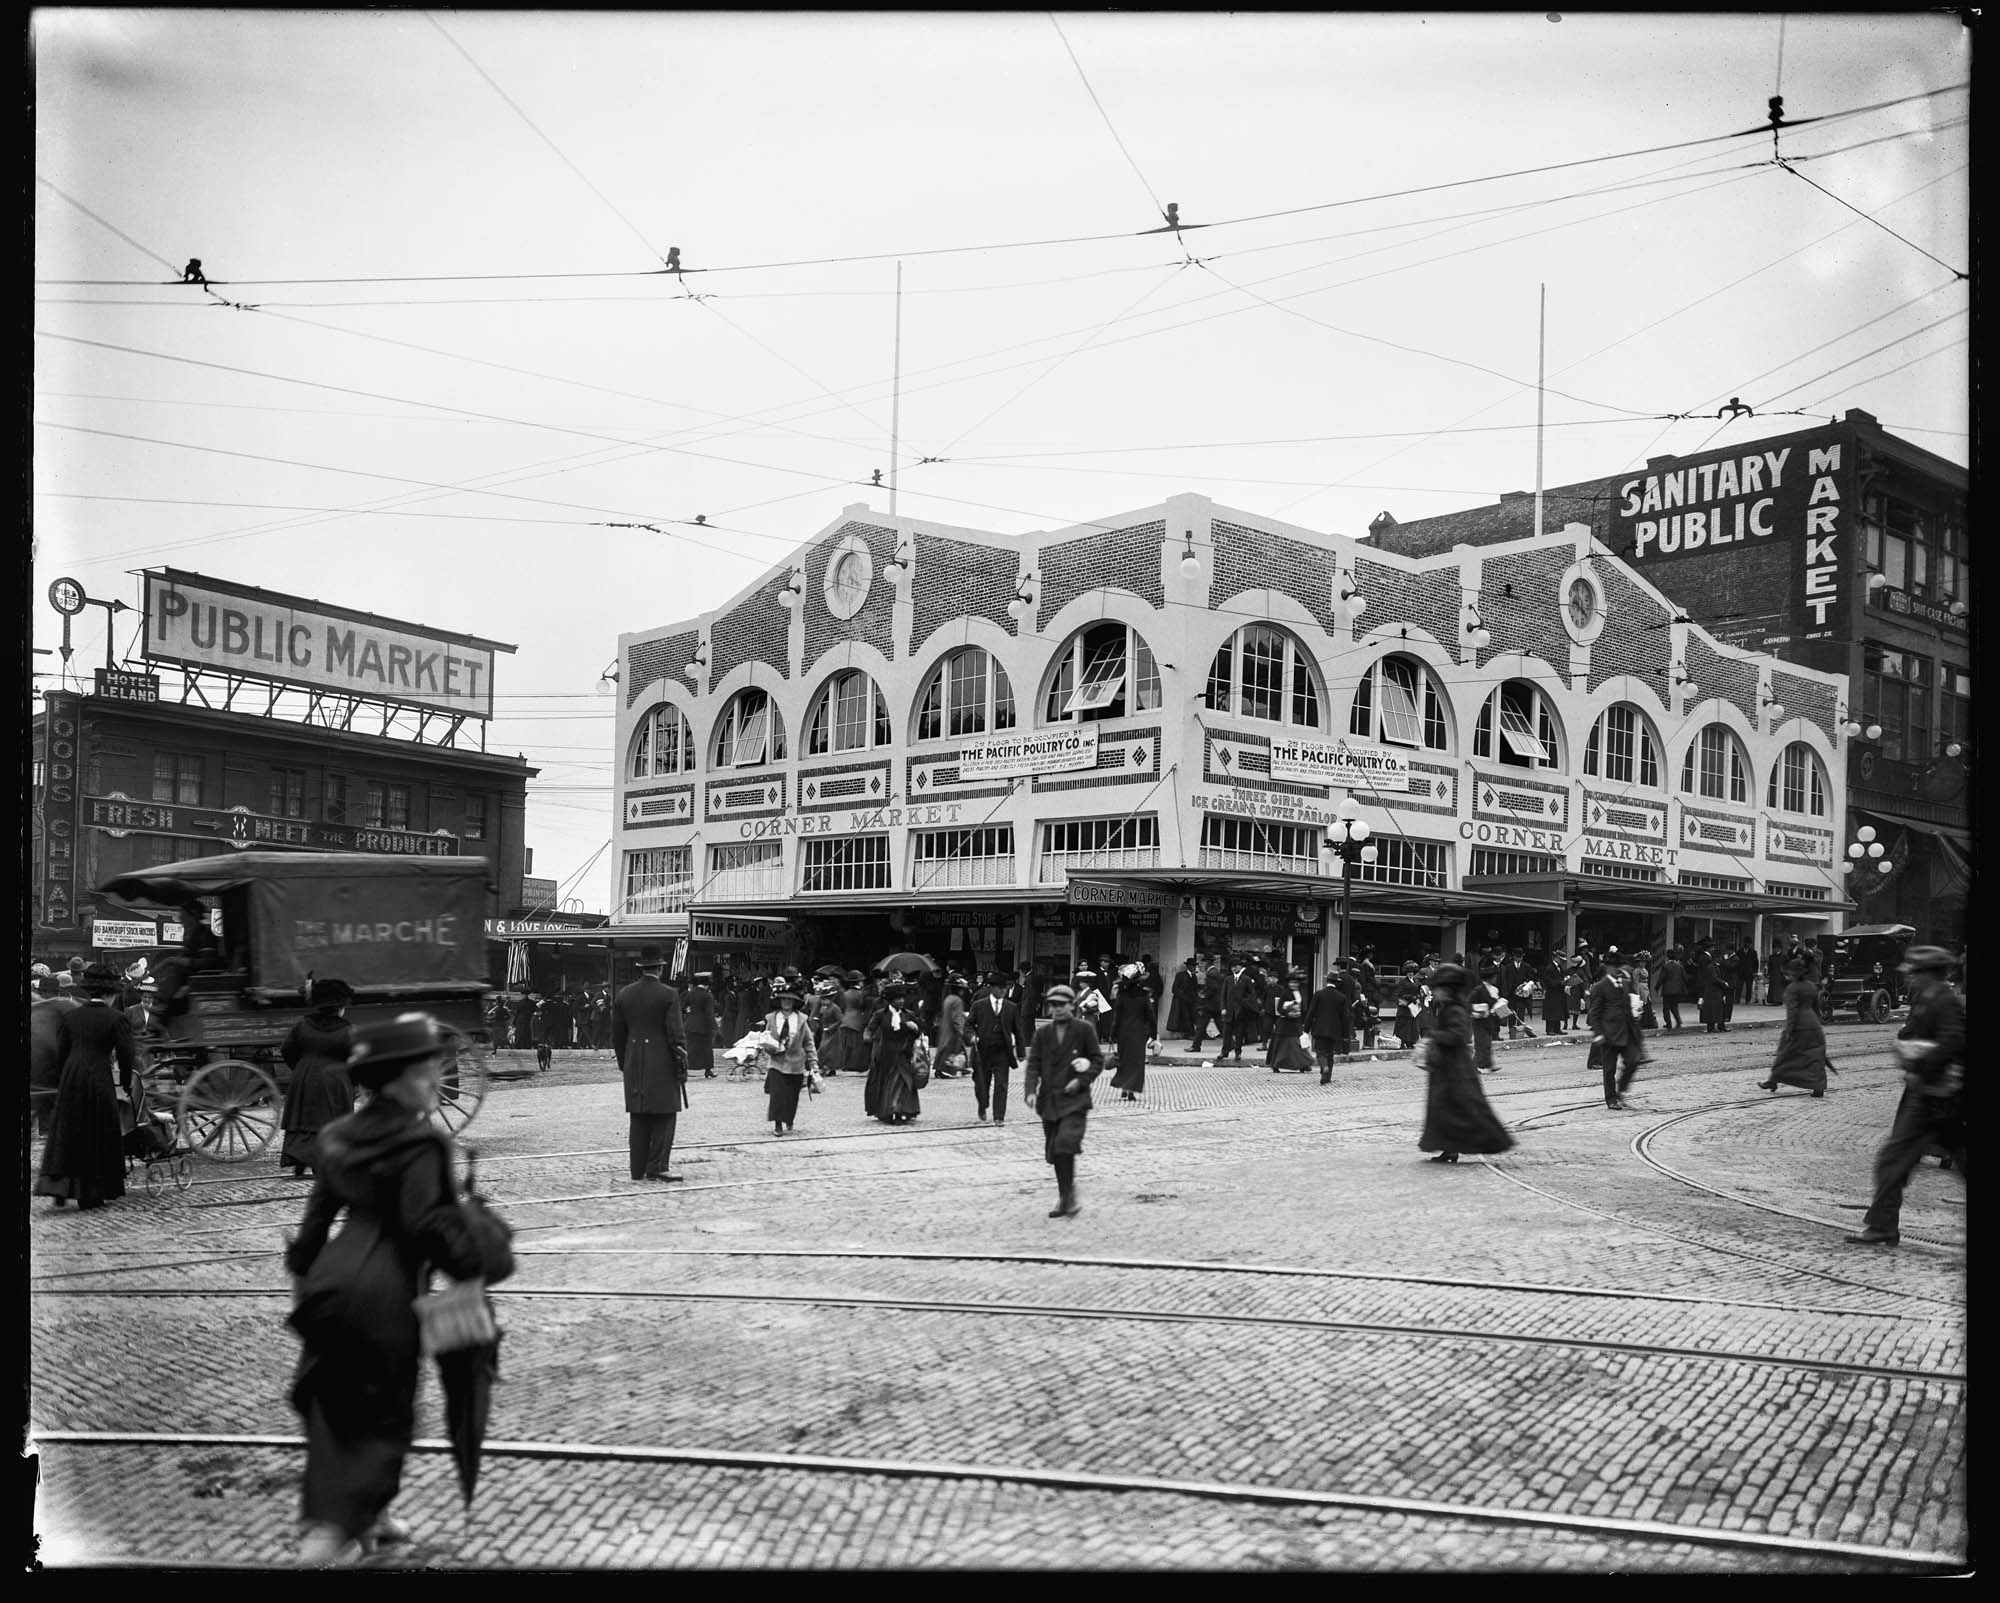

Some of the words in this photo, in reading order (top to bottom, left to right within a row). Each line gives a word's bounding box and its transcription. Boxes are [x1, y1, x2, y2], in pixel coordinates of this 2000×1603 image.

[1621, 447, 1791, 517] SANITARY
[1635, 498, 1774, 558] PUBLIC
[1806, 444, 1841, 625] MARKET
[56, 588, 76, 597] PUR
[158, 589, 312, 667] PUBLIC
[326, 624, 483, 698] MARKET
[107, 673, 155, 688] HOTEL
[100, 685, 156, 702] LELAND
[53, 696, 75, 803] FOODS
[961, 748, 983, 760] THE
[986, 744, 1021, 759] PACIFIC
[1023, 739, 1064, 756] POULTRY
[988, 739, 1009, 747] FLOOR
[1034, 731, 1069, 741] OCCUPIED
[1301, 742, 1324, 751] FLOOR
[1273, 746, 1298, 761] THE
[1301, 749, 1343, 766] PACIFIC
[1346, 754, 1383, 769] POULTRY
[1232, 788, 1267, 804] THREE
[1271, 794, 1304, 808] GIRLS
[93, 801, 173, 829] FRESH
[1191, 795, 1209, 808] ICE
[1212, 798, 1248, 814] CREAM
[1248, 803, 1256, 815] &
[1260, 804, 1295, 820] COFFEE
[1298, 809, 1338, 824] PARLOR
[740, 814, 832, 838] CORNER
[850, 803, 962, 830] MARKET
[255, 819, 311, 844] MEET
[320, 830, 345, 844] THE
[355, 830, 450, 856] PRODUCER
[1459, 821, 1563, 851] CORNER
[1584, 838, 1679, 866] MARKET
[47, 818, 71, 924] CHEAP
[1074, 885, 1125, 903] CORNER
[1129, 890, 1176, 906] MARKET
[1231, 898, 1261, 910] THREE
[1265, 903, 1290, 913] GIRLS
[496, 920, 505, 933] &
[941, 911, 970, 926] BUTTER
[972, 911, 997, 926] STORE
[1069, 911, 1120, 925] BAKERY
[1235, 914, 1287, 930] BAKERY
[102, 925, 125, 935] BANKRUPT
[695, 921, 723, 937] MAIN
[727, 923, 766, 939] FLOOR
